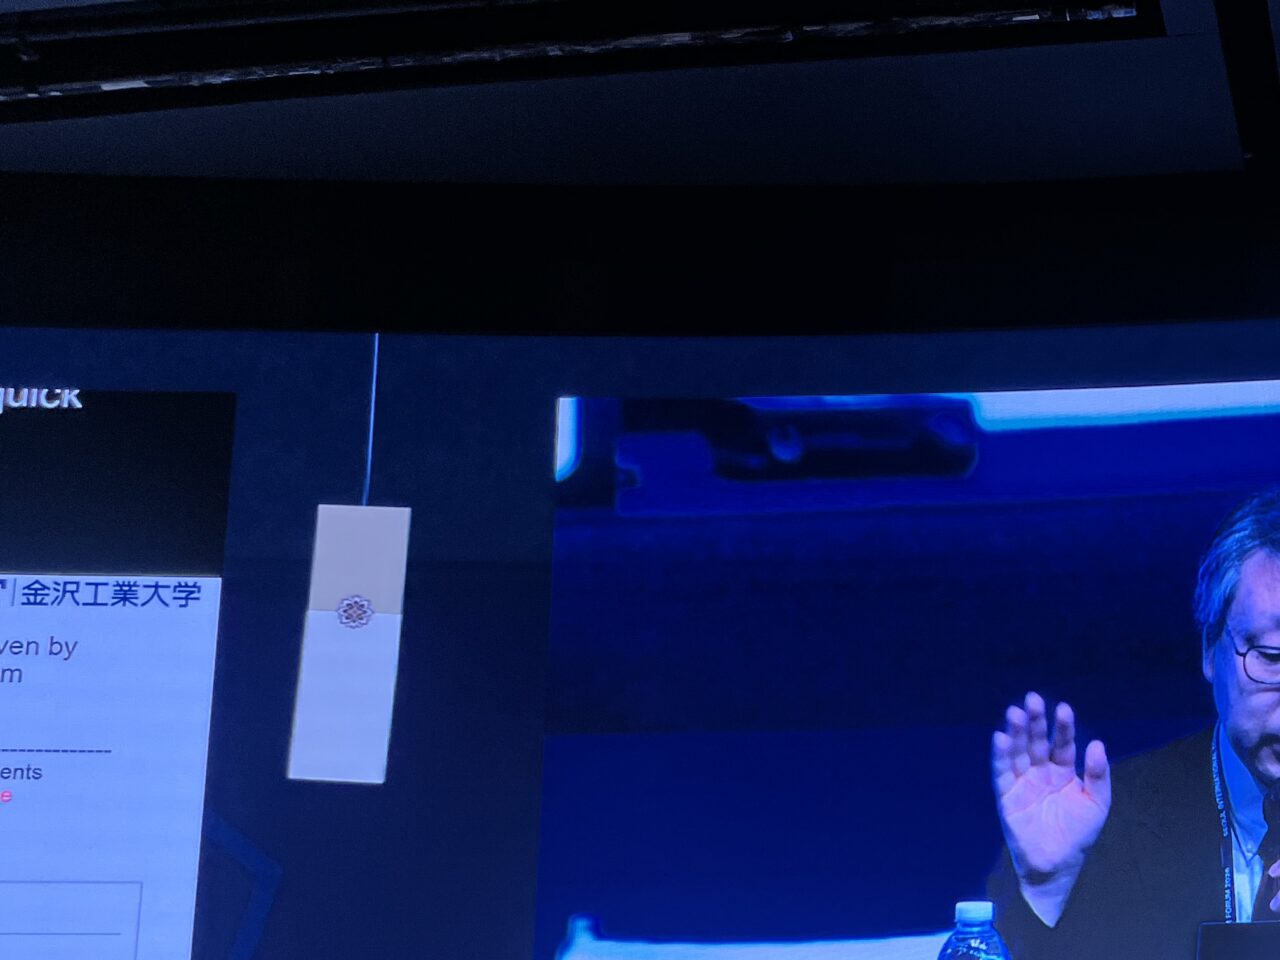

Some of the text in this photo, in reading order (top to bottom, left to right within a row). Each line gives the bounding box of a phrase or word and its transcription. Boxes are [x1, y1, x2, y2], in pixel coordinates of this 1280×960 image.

[20, 579, 202, 608] 金沢工業大学
[48, 636, 78, 661] by
